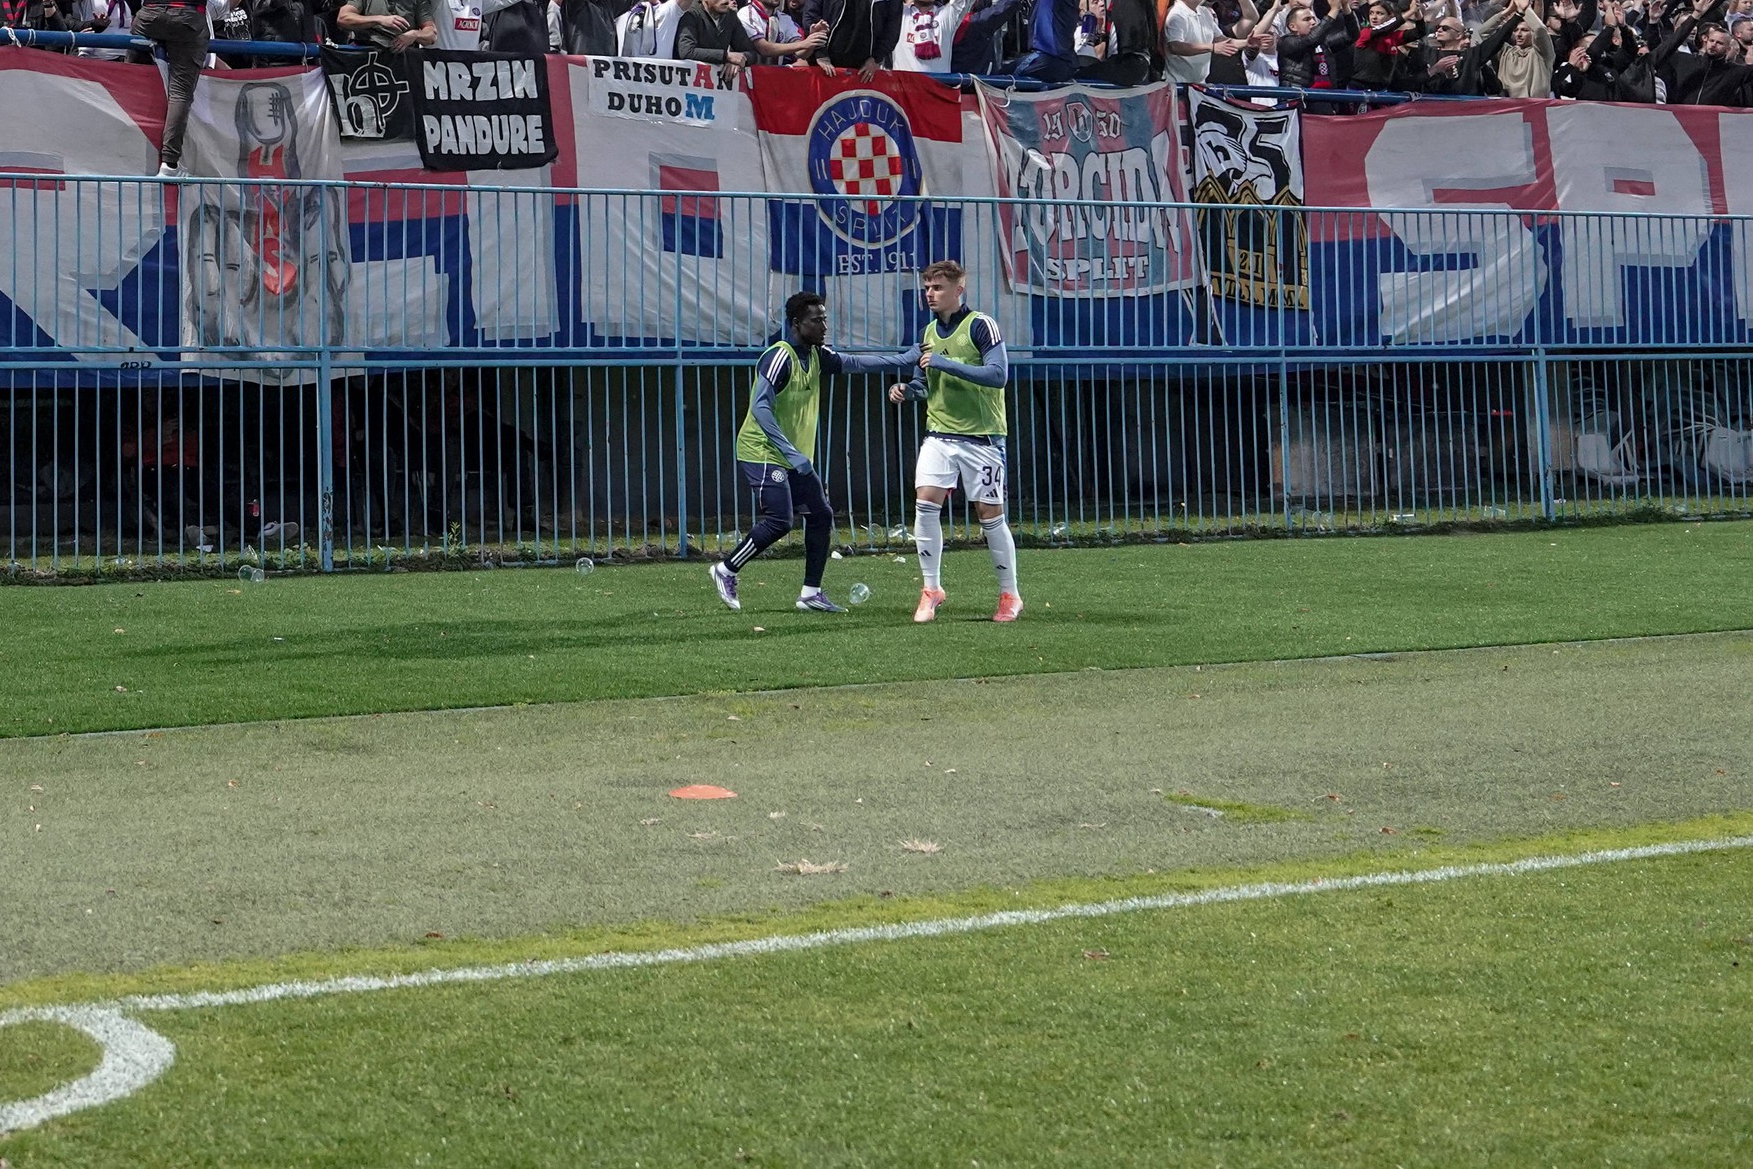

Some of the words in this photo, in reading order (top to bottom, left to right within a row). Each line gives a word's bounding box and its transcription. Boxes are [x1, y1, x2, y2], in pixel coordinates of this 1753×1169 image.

[423, 59, 539, 102] MRZIN
[594, 59, 735, 91] PRISUTAN
[607, 91, 716, 121] DUHOM
[817, 99, 905, 141] HAJDUK
[423, 114, 545, 156] PANDURE
[835, 205, 907, 239] SPLIT
[1046, 255, 1150, 281] SPLIT
[981, 465, 1001, 488] 34
